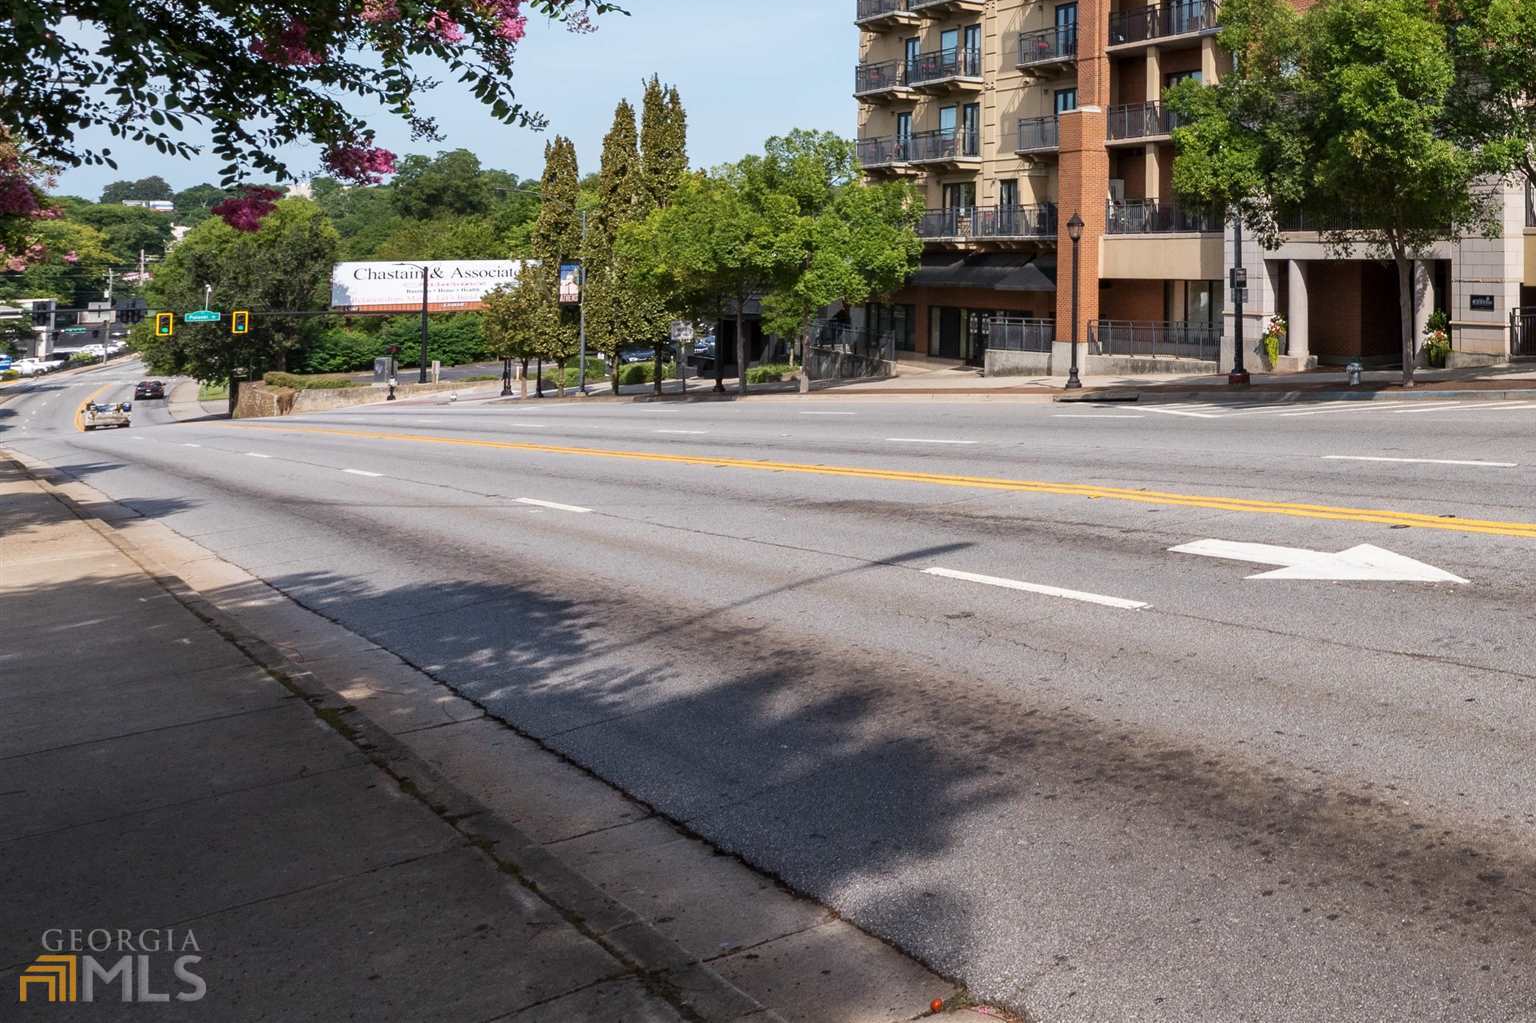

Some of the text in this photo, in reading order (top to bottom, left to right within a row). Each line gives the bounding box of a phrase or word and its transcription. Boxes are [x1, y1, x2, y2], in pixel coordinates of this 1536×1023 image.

[353, 265, 517, 281] Chastain & Associat
